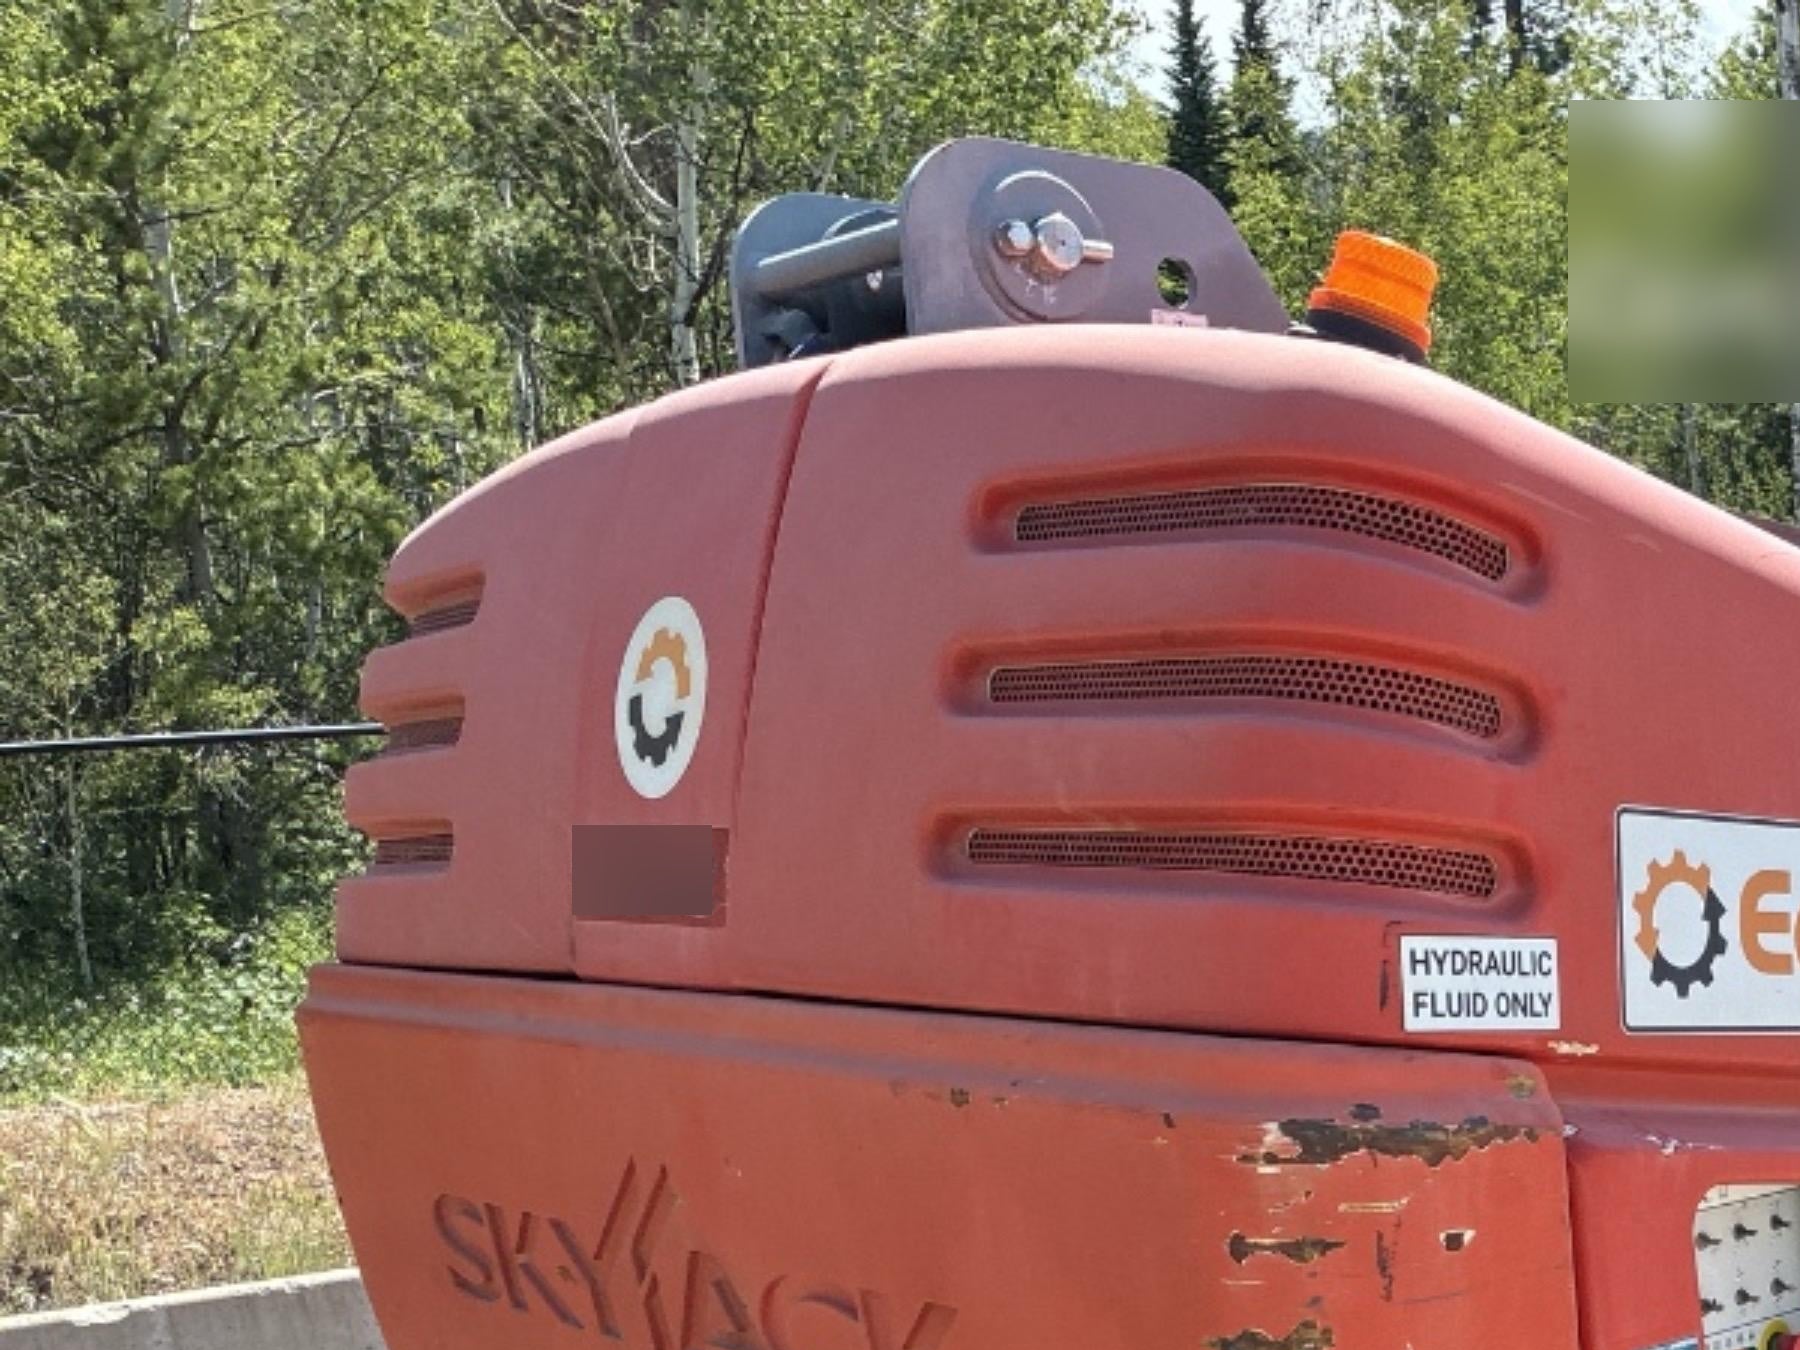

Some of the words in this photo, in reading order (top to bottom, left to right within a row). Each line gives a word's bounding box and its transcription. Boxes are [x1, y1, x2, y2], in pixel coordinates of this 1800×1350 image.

[1408, 948, 1552, 976] HYDRAULIC
[1412, 991, 1489, 1018] FLUID
[1495, 991, 1552, 1018] ONLY
